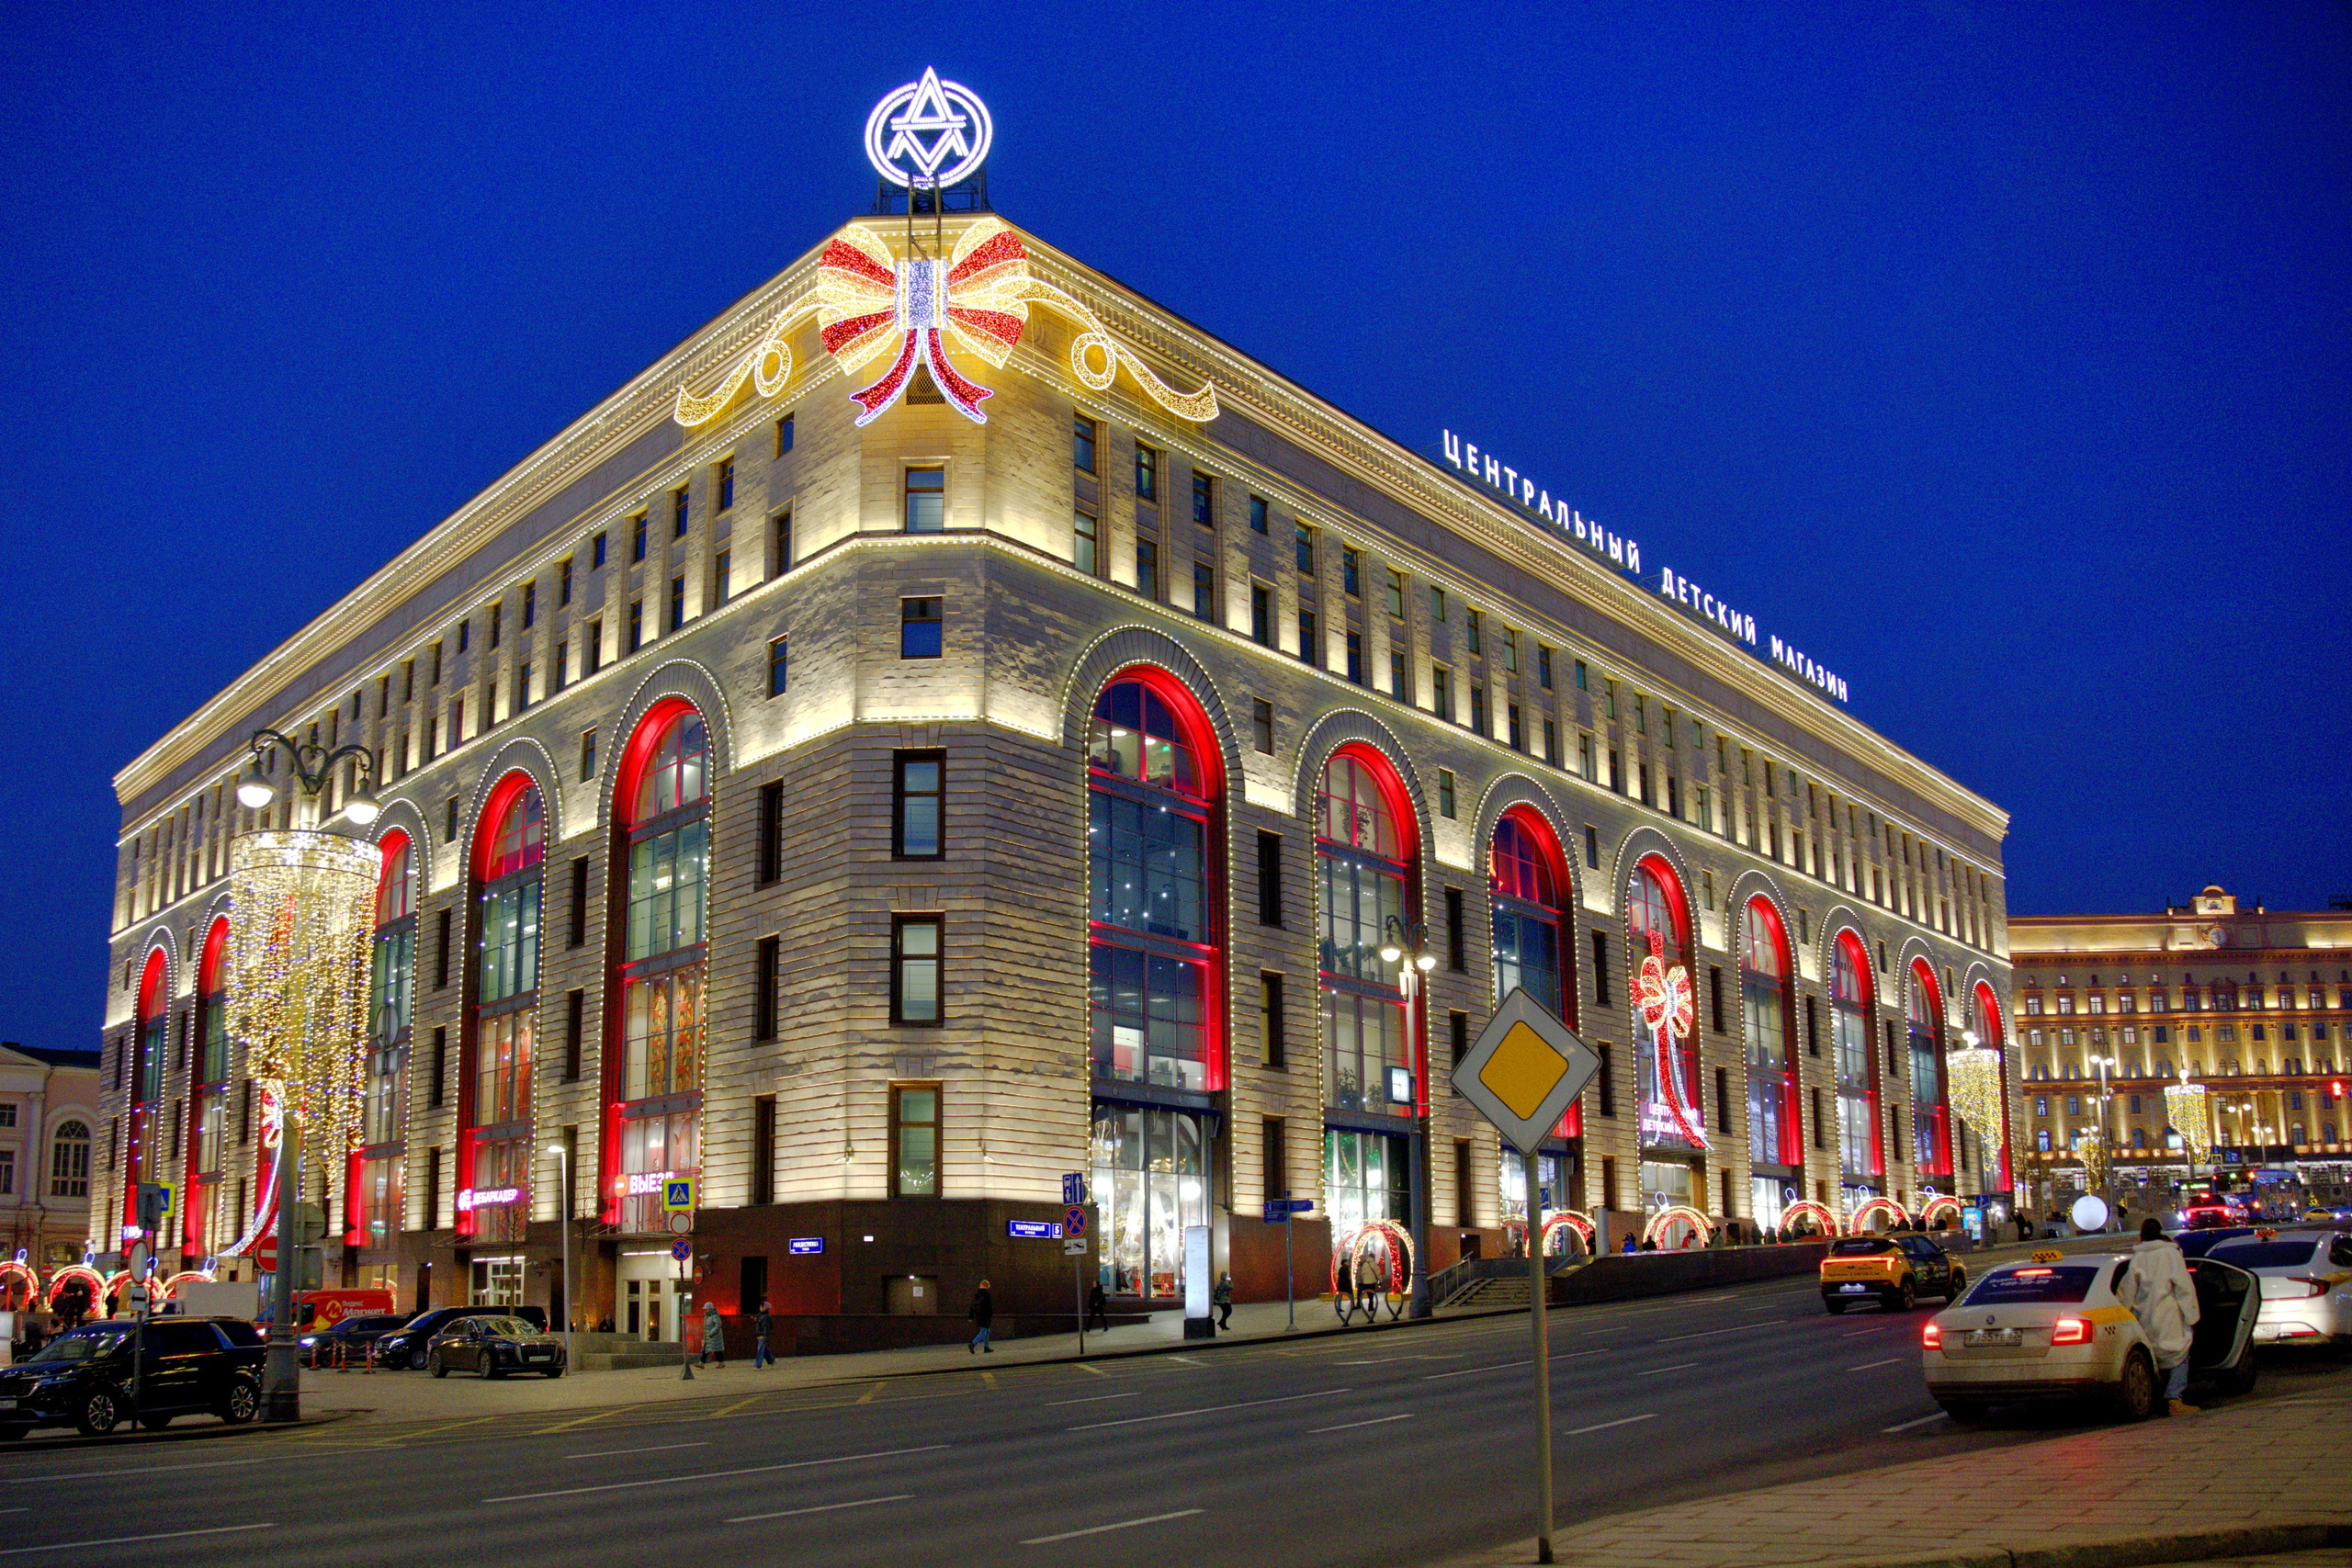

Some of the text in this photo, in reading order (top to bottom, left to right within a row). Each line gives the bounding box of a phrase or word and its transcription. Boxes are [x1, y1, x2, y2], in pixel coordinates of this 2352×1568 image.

[1443, 429, 1849, 703] ЦЕНТРАЛЬНЫЙ ДЕТСКИЙ МАГАЗИН
[472, 1189, 518, 1207] ДЕБАРКАДЕР
[1054, 1225, 1060, 1235] 5
